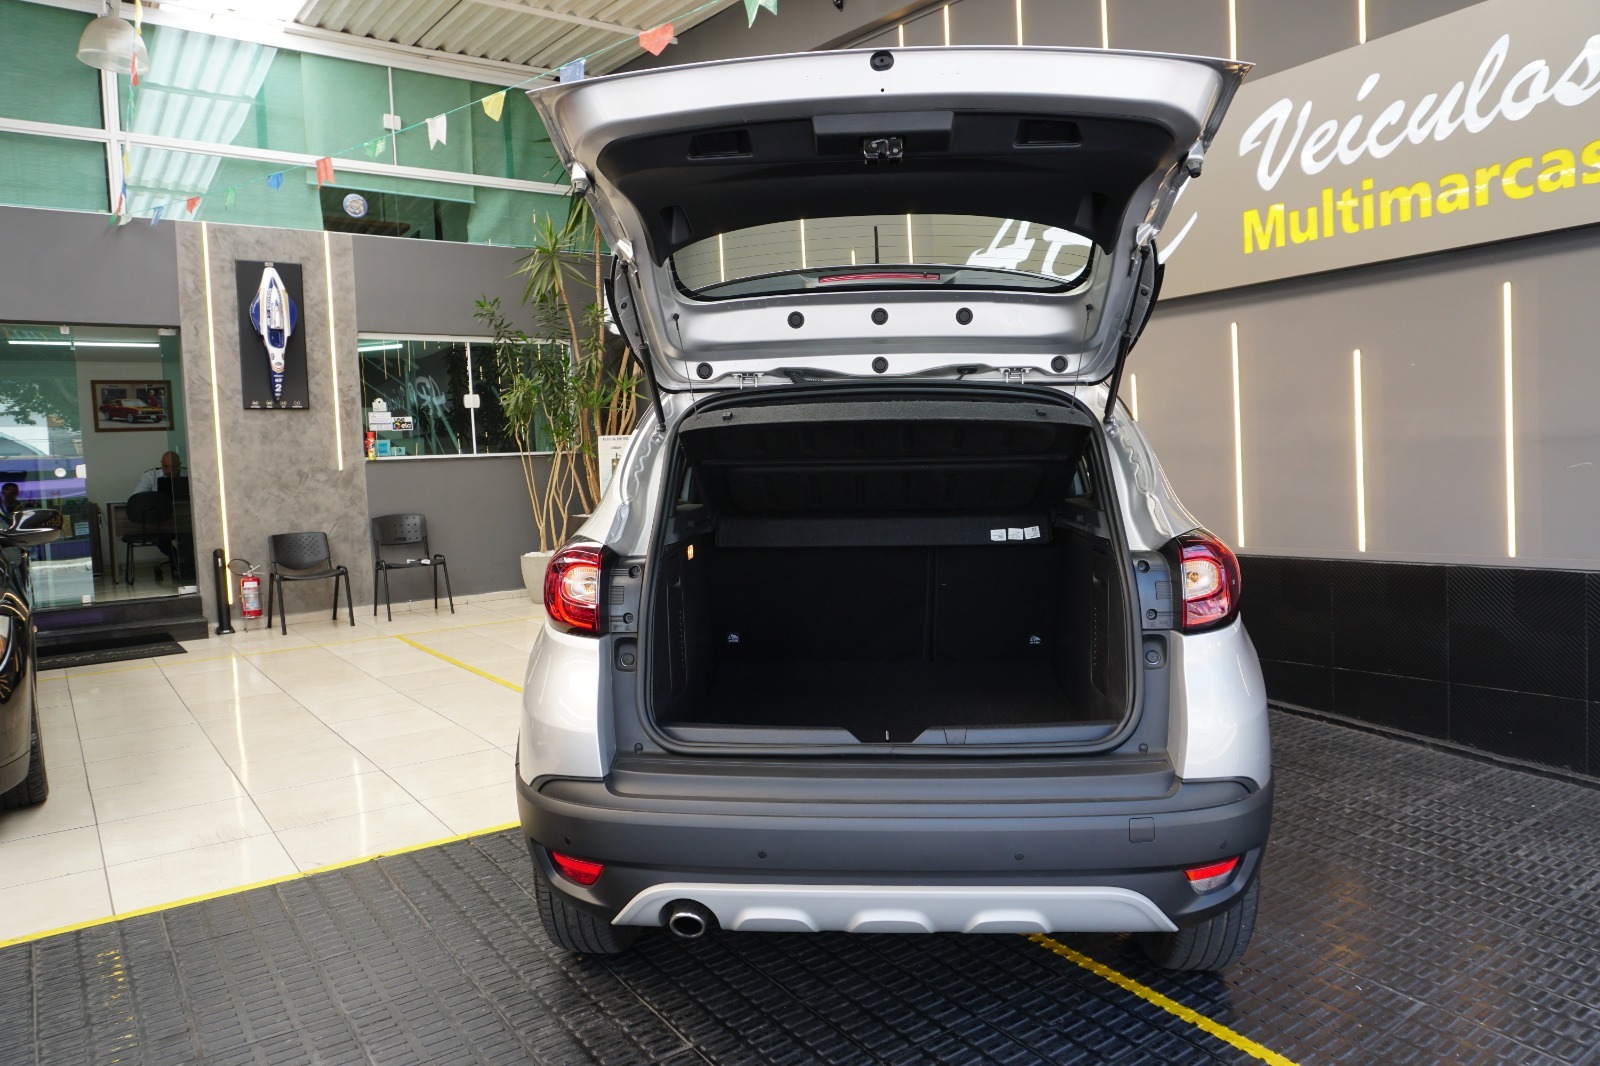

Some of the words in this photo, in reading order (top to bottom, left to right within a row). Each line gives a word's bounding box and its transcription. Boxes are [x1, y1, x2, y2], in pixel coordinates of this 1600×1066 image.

[1239, 33, 1600, 191] Veículos
[1242, 139, 1600, 254] Multimarcas
[275, 383, 282, 392] 2
